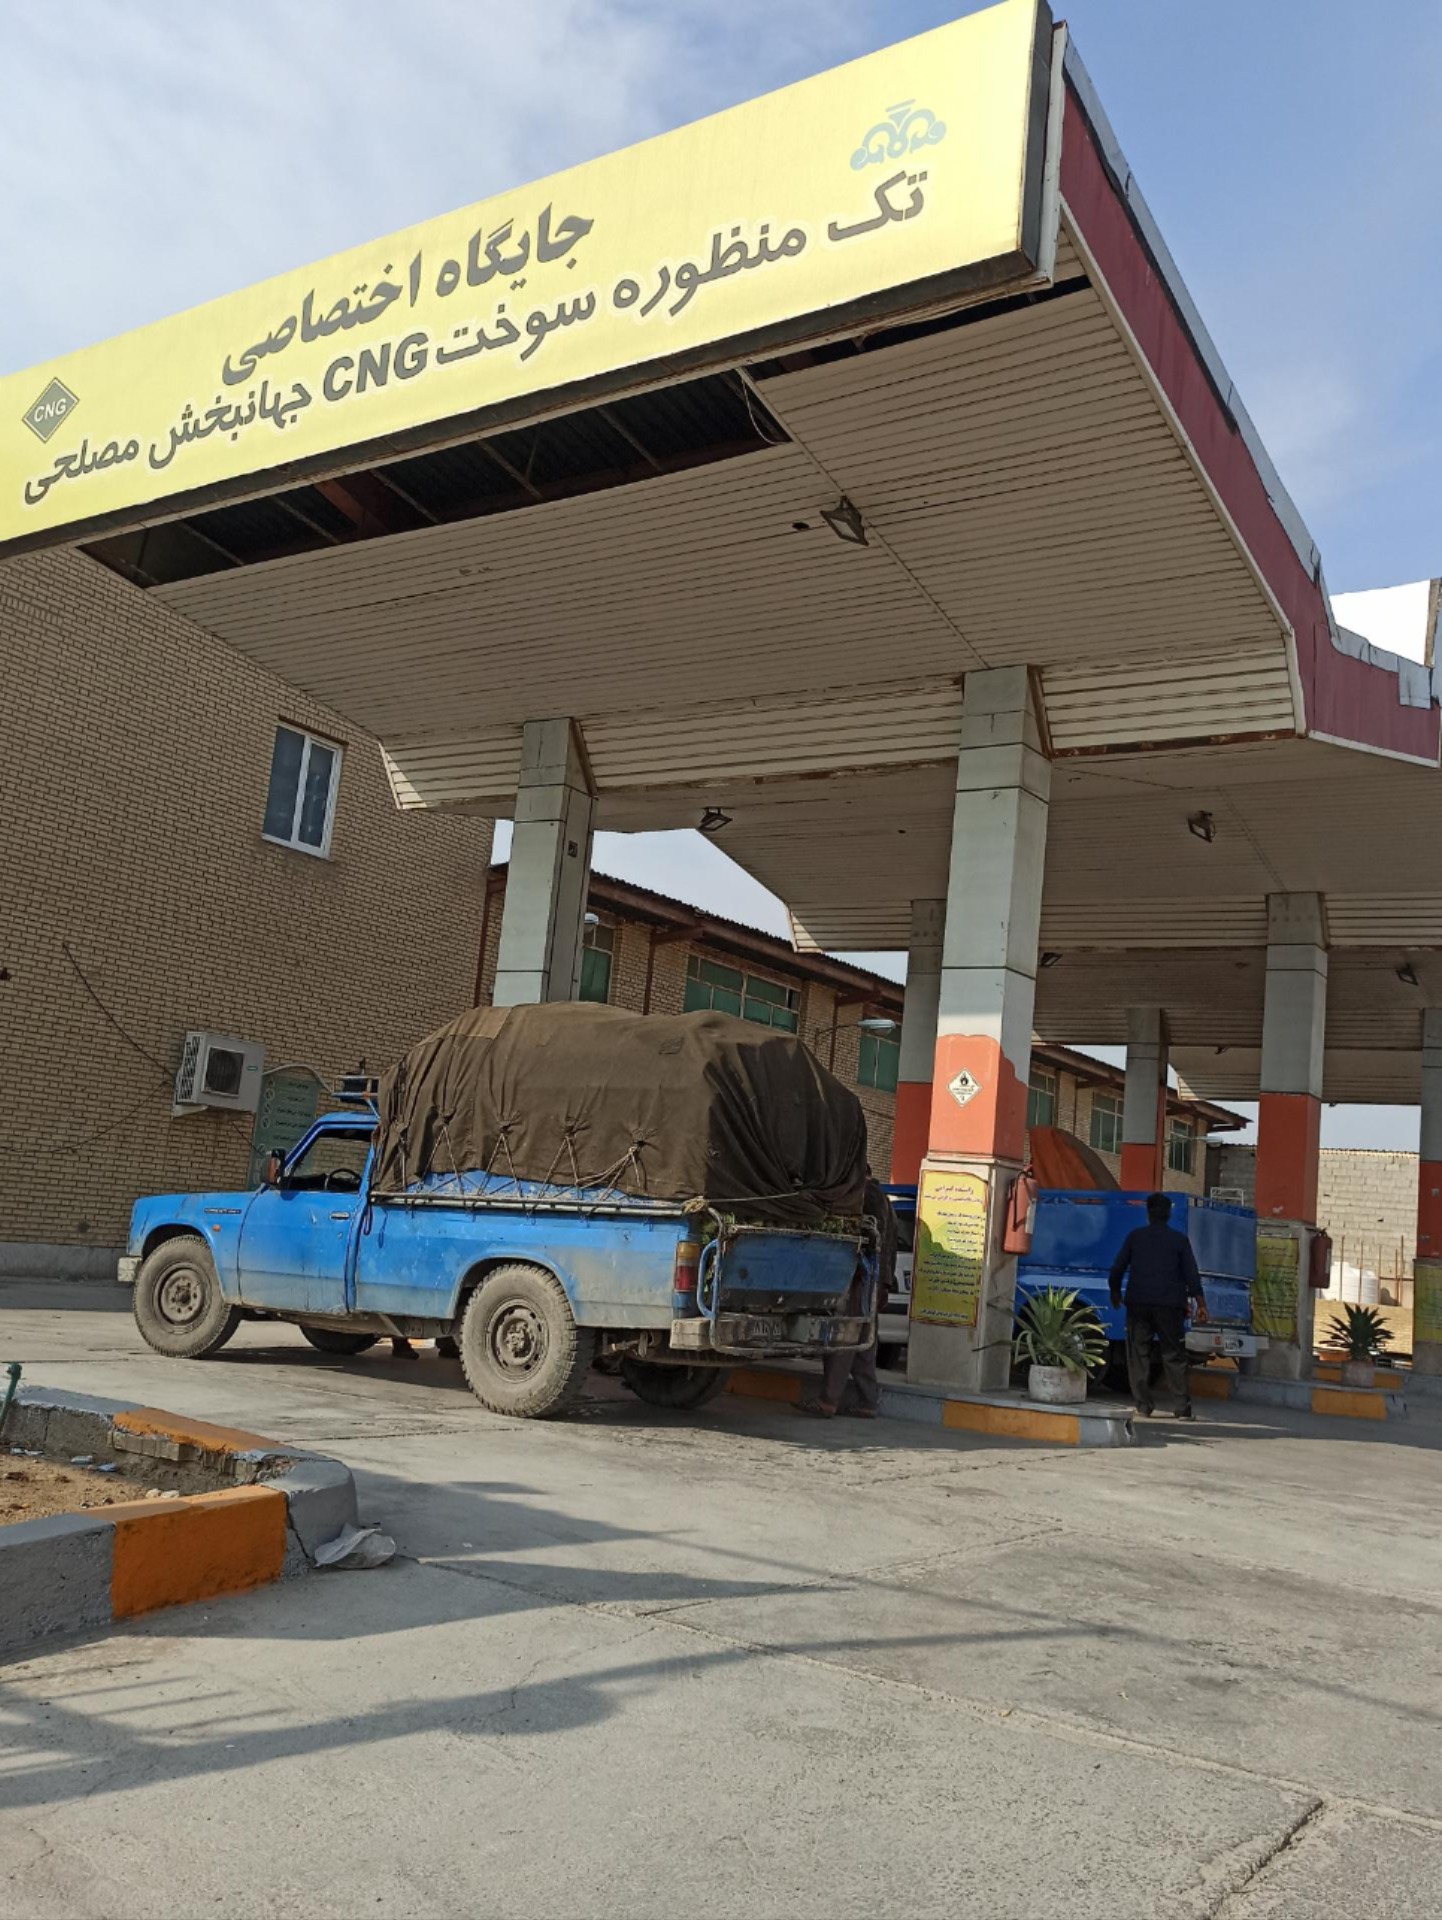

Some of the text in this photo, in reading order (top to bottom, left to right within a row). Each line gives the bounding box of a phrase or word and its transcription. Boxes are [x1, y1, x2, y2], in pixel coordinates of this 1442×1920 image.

[25, 171, 928, 506] تک منظوره سوخت CNG جهانبخش مصلحی
[222, 203, 595, 387] جایگاه اختصاصی
[34, 398, 67, 423] CNG
